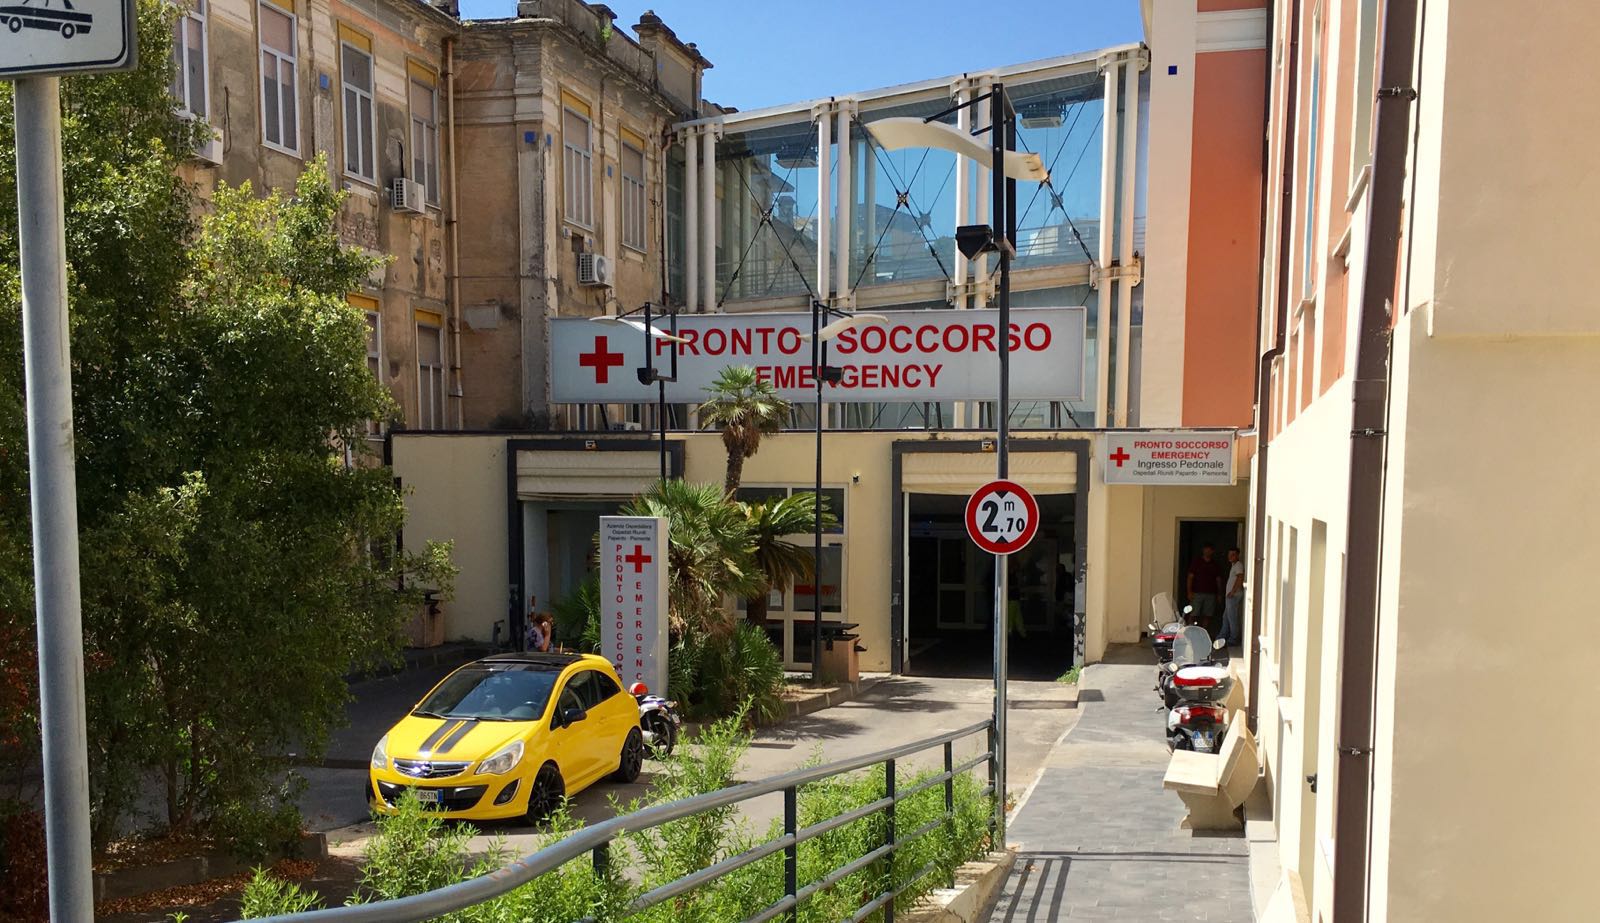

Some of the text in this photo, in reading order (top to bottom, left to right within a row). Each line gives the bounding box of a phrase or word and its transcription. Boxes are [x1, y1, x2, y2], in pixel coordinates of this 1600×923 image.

[655, 322, 1052, 356] PRONTO SOCCORSO
[1134, 441, 1229, 449] PRONTO SOCCORSO
[1137, 460, 1224, 470] Ingresso Pedonale
